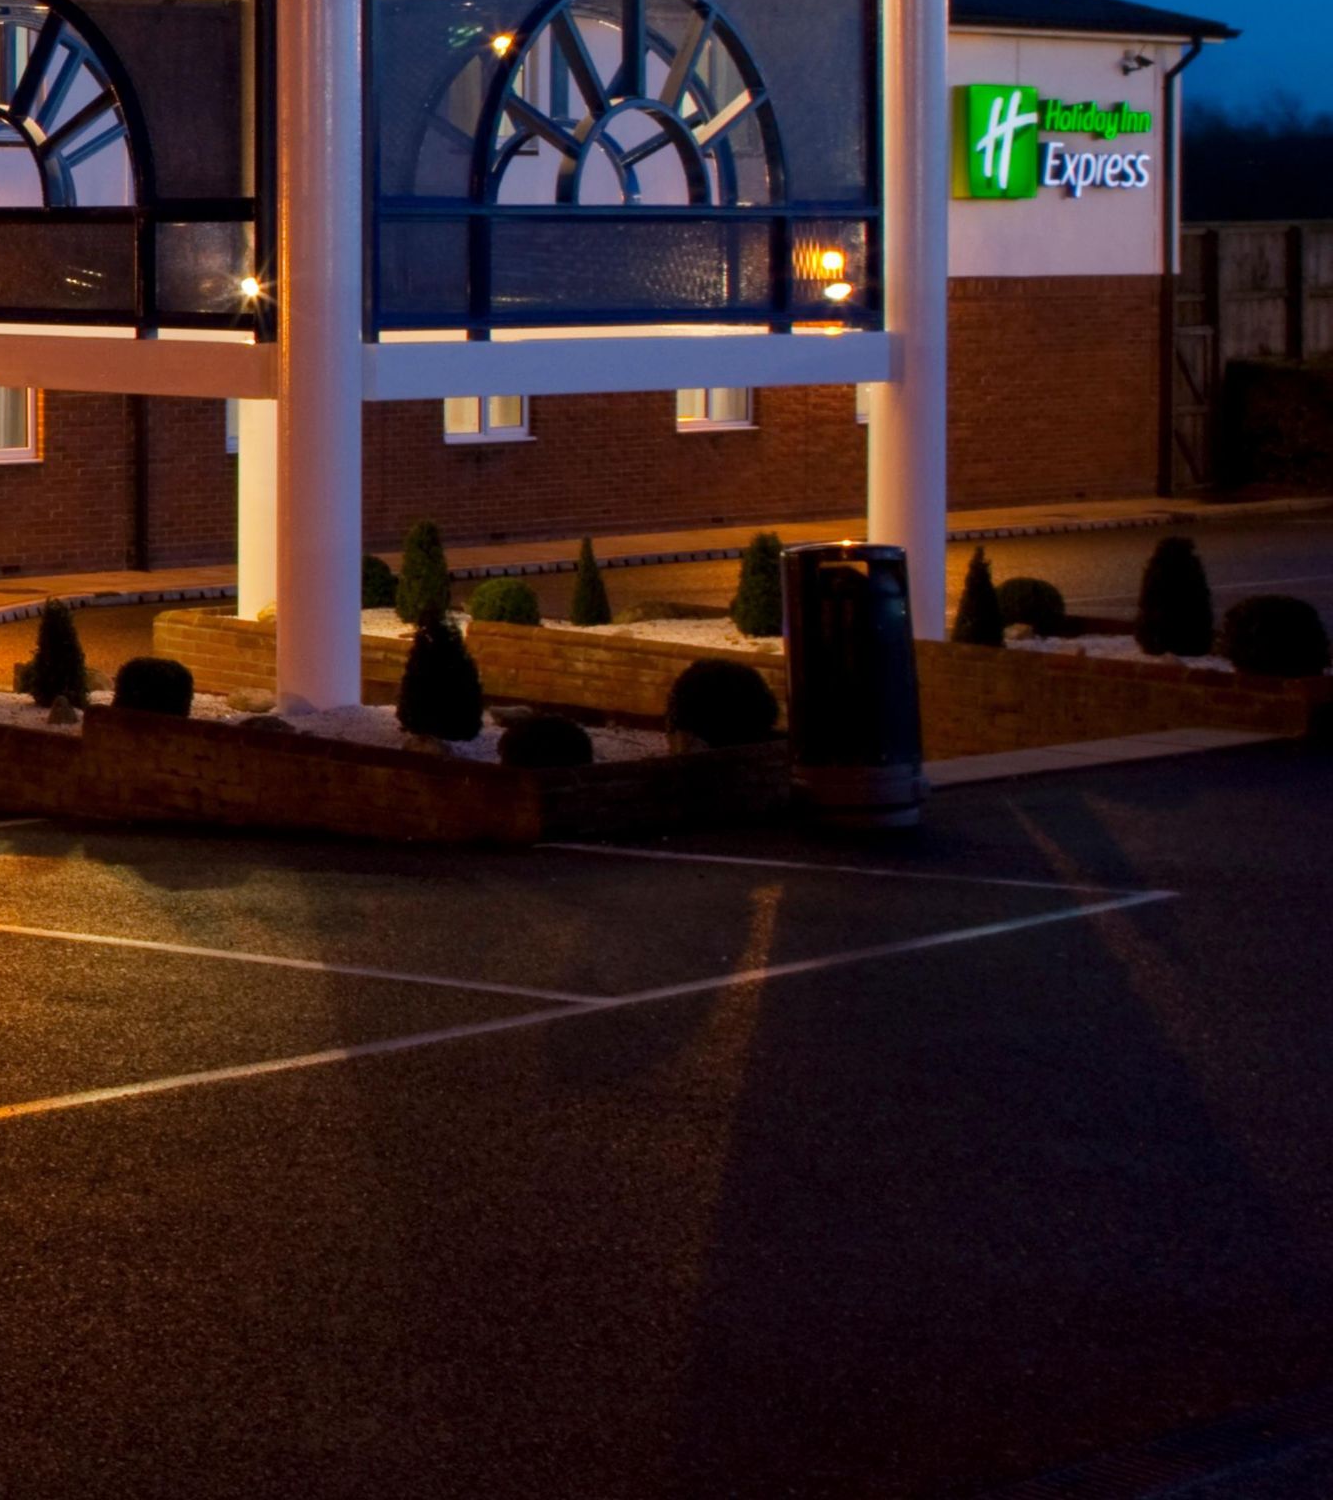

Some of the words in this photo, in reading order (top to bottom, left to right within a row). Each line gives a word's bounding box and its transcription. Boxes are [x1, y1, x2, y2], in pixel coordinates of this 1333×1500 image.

[1045, 99, 1119, 140] Holiday
[1121, 101, 1151, 133] Inn
[1044, 141, 1151, 198] Express
